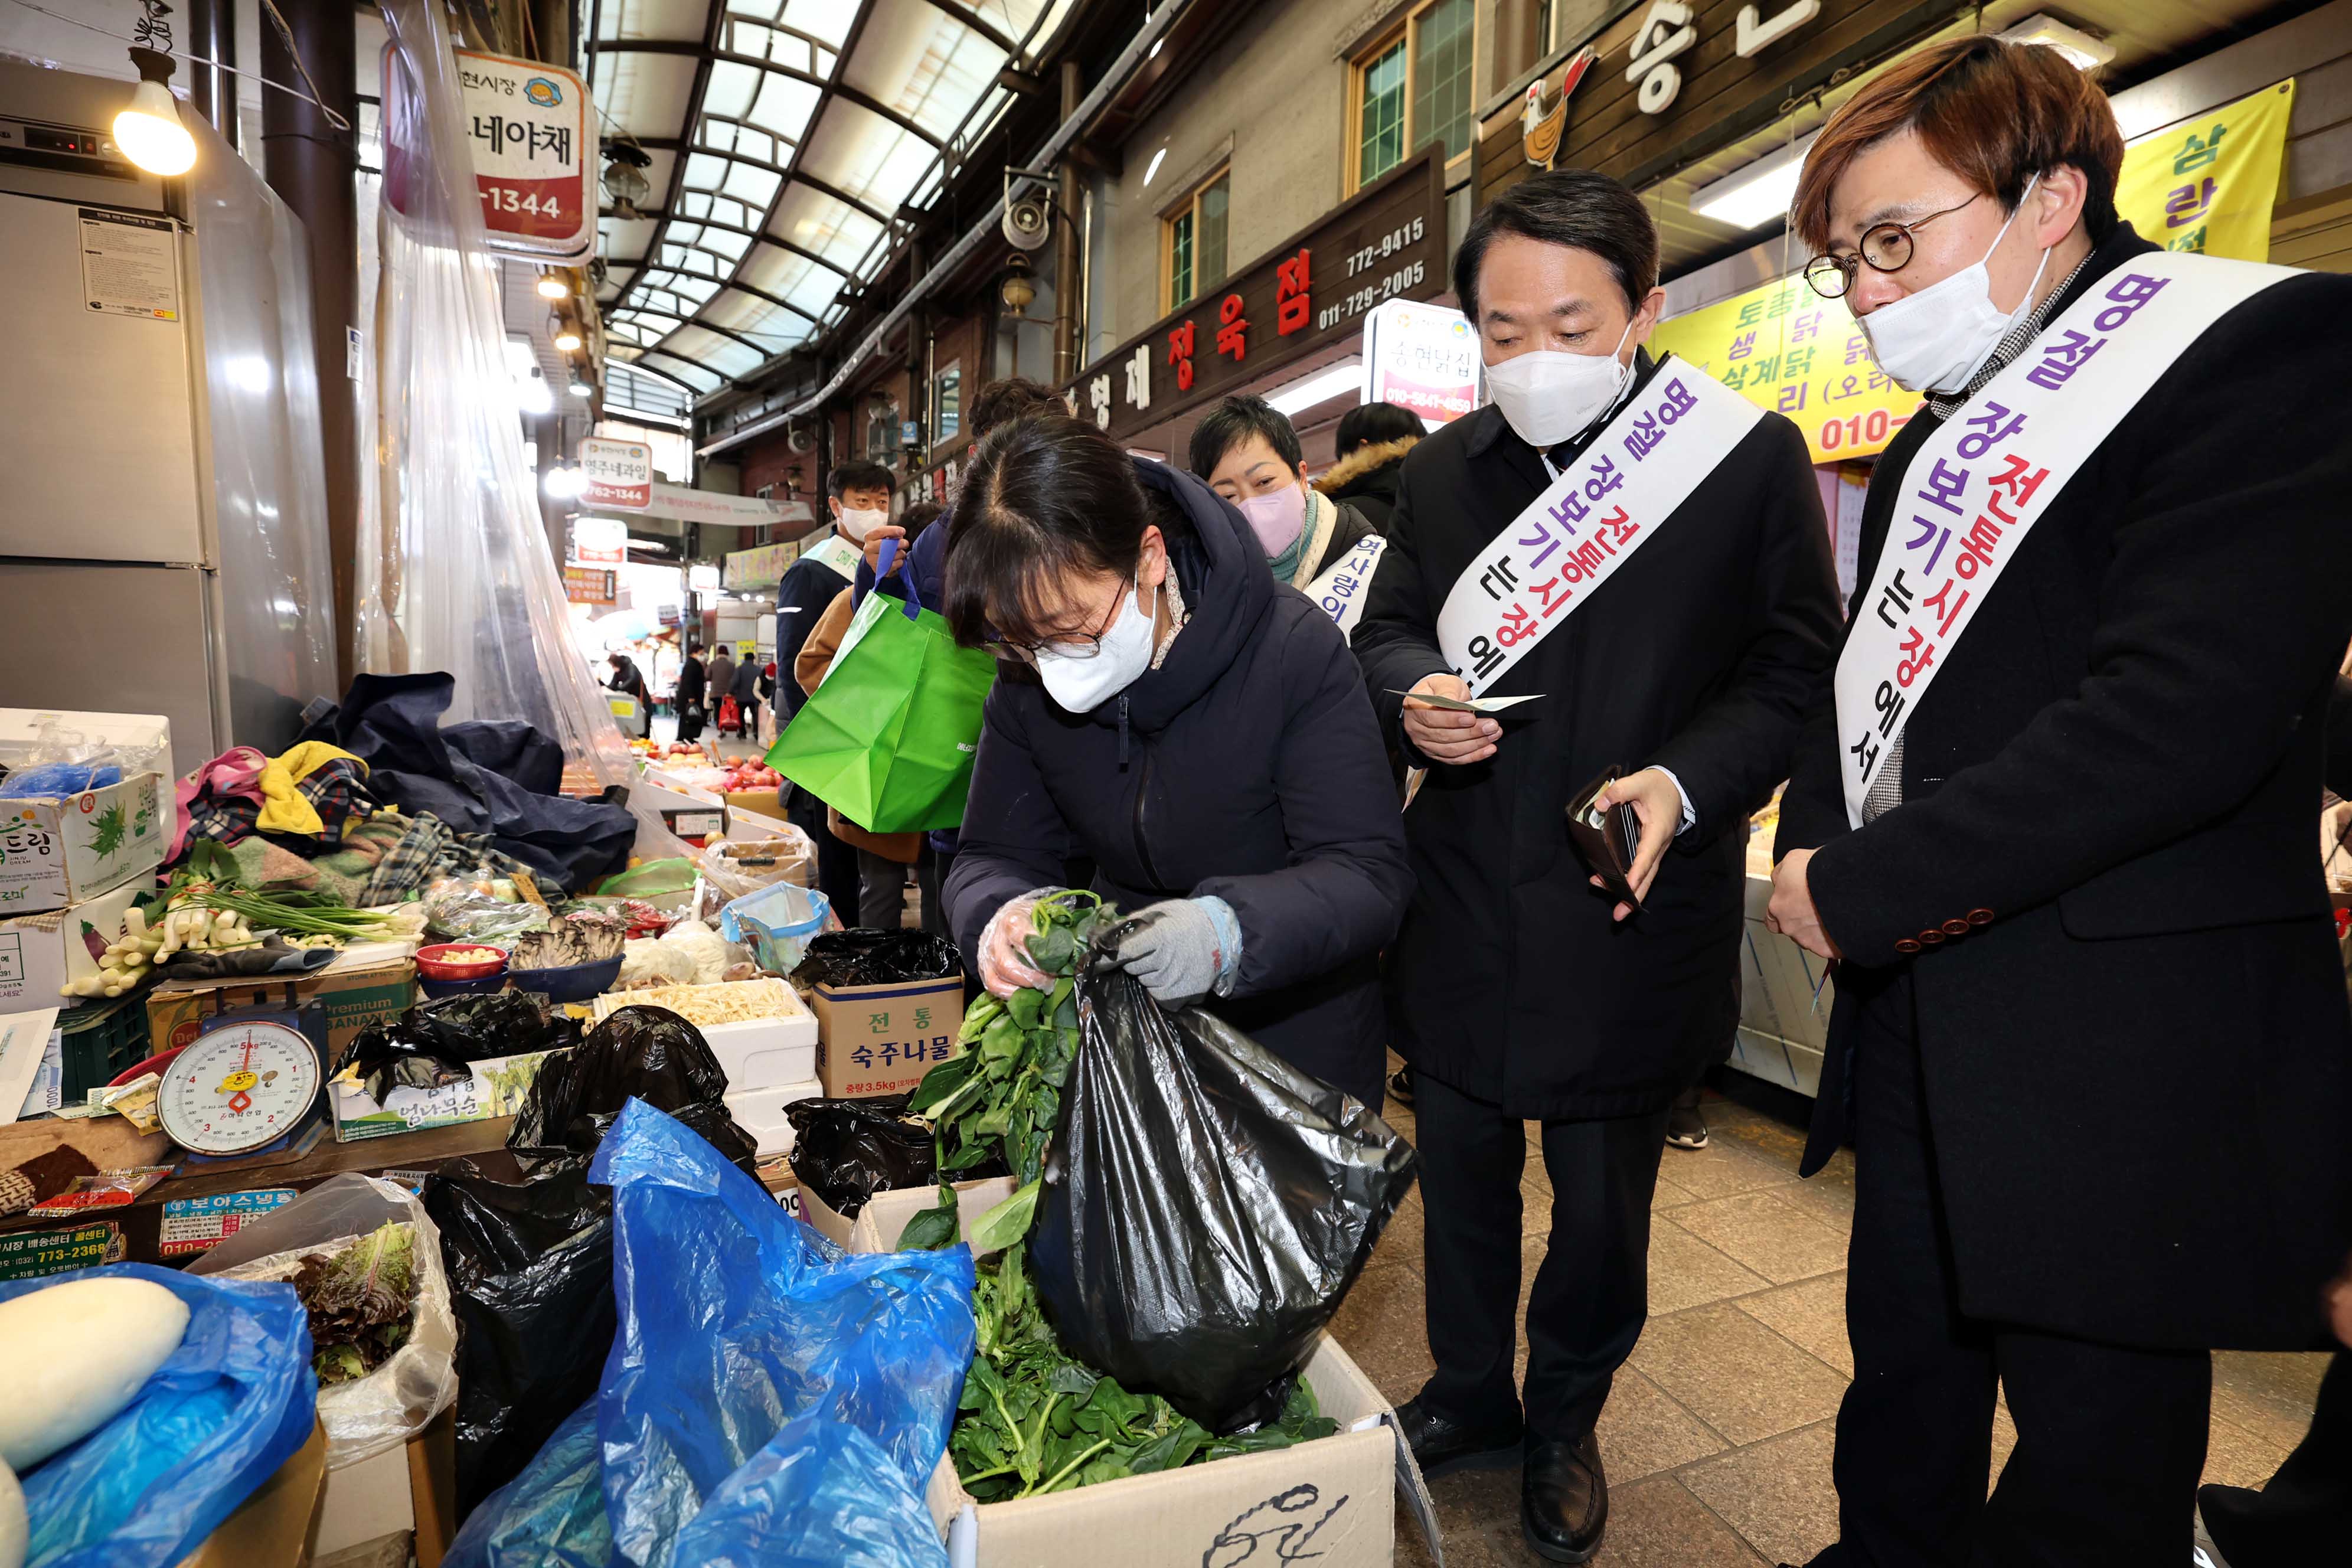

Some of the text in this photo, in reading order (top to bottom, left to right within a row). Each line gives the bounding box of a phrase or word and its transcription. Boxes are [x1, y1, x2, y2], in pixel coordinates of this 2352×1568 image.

[468, 115, 570, 166] 네야채
[1347, 216, 1423, 277] 772-9415
[1319, 260, 1424, 330] 011-729-2005
[1168, 248, 1314, 391] 정육점
[1822, 403, 1928, 450] 010-
[1877, 273, 2171, 630] 명절 장보기는
[1479, 377, 1698, 600] 명절 장보기는
[1455, 505, 1640, 690] 전통시장에
[1850, 453, 2050, 784] 전통시장에서
[6, 833, 50, 855] 드림
[326, 999, 391, 1014] Premium
[326, 1010, 401, 1030] BANANAS
[851, 1035, 950, 1069] 숙주나물
[845, 1082, 864, 1093] 중량
[865, 1081, 896, 1093] 3.5kg
[204, 1123, 211, 1132] 3
[0, 1229, 106, 1252] 시장 배송센터 콜센터
[38, 1243, 105, 1263] 773-2368
